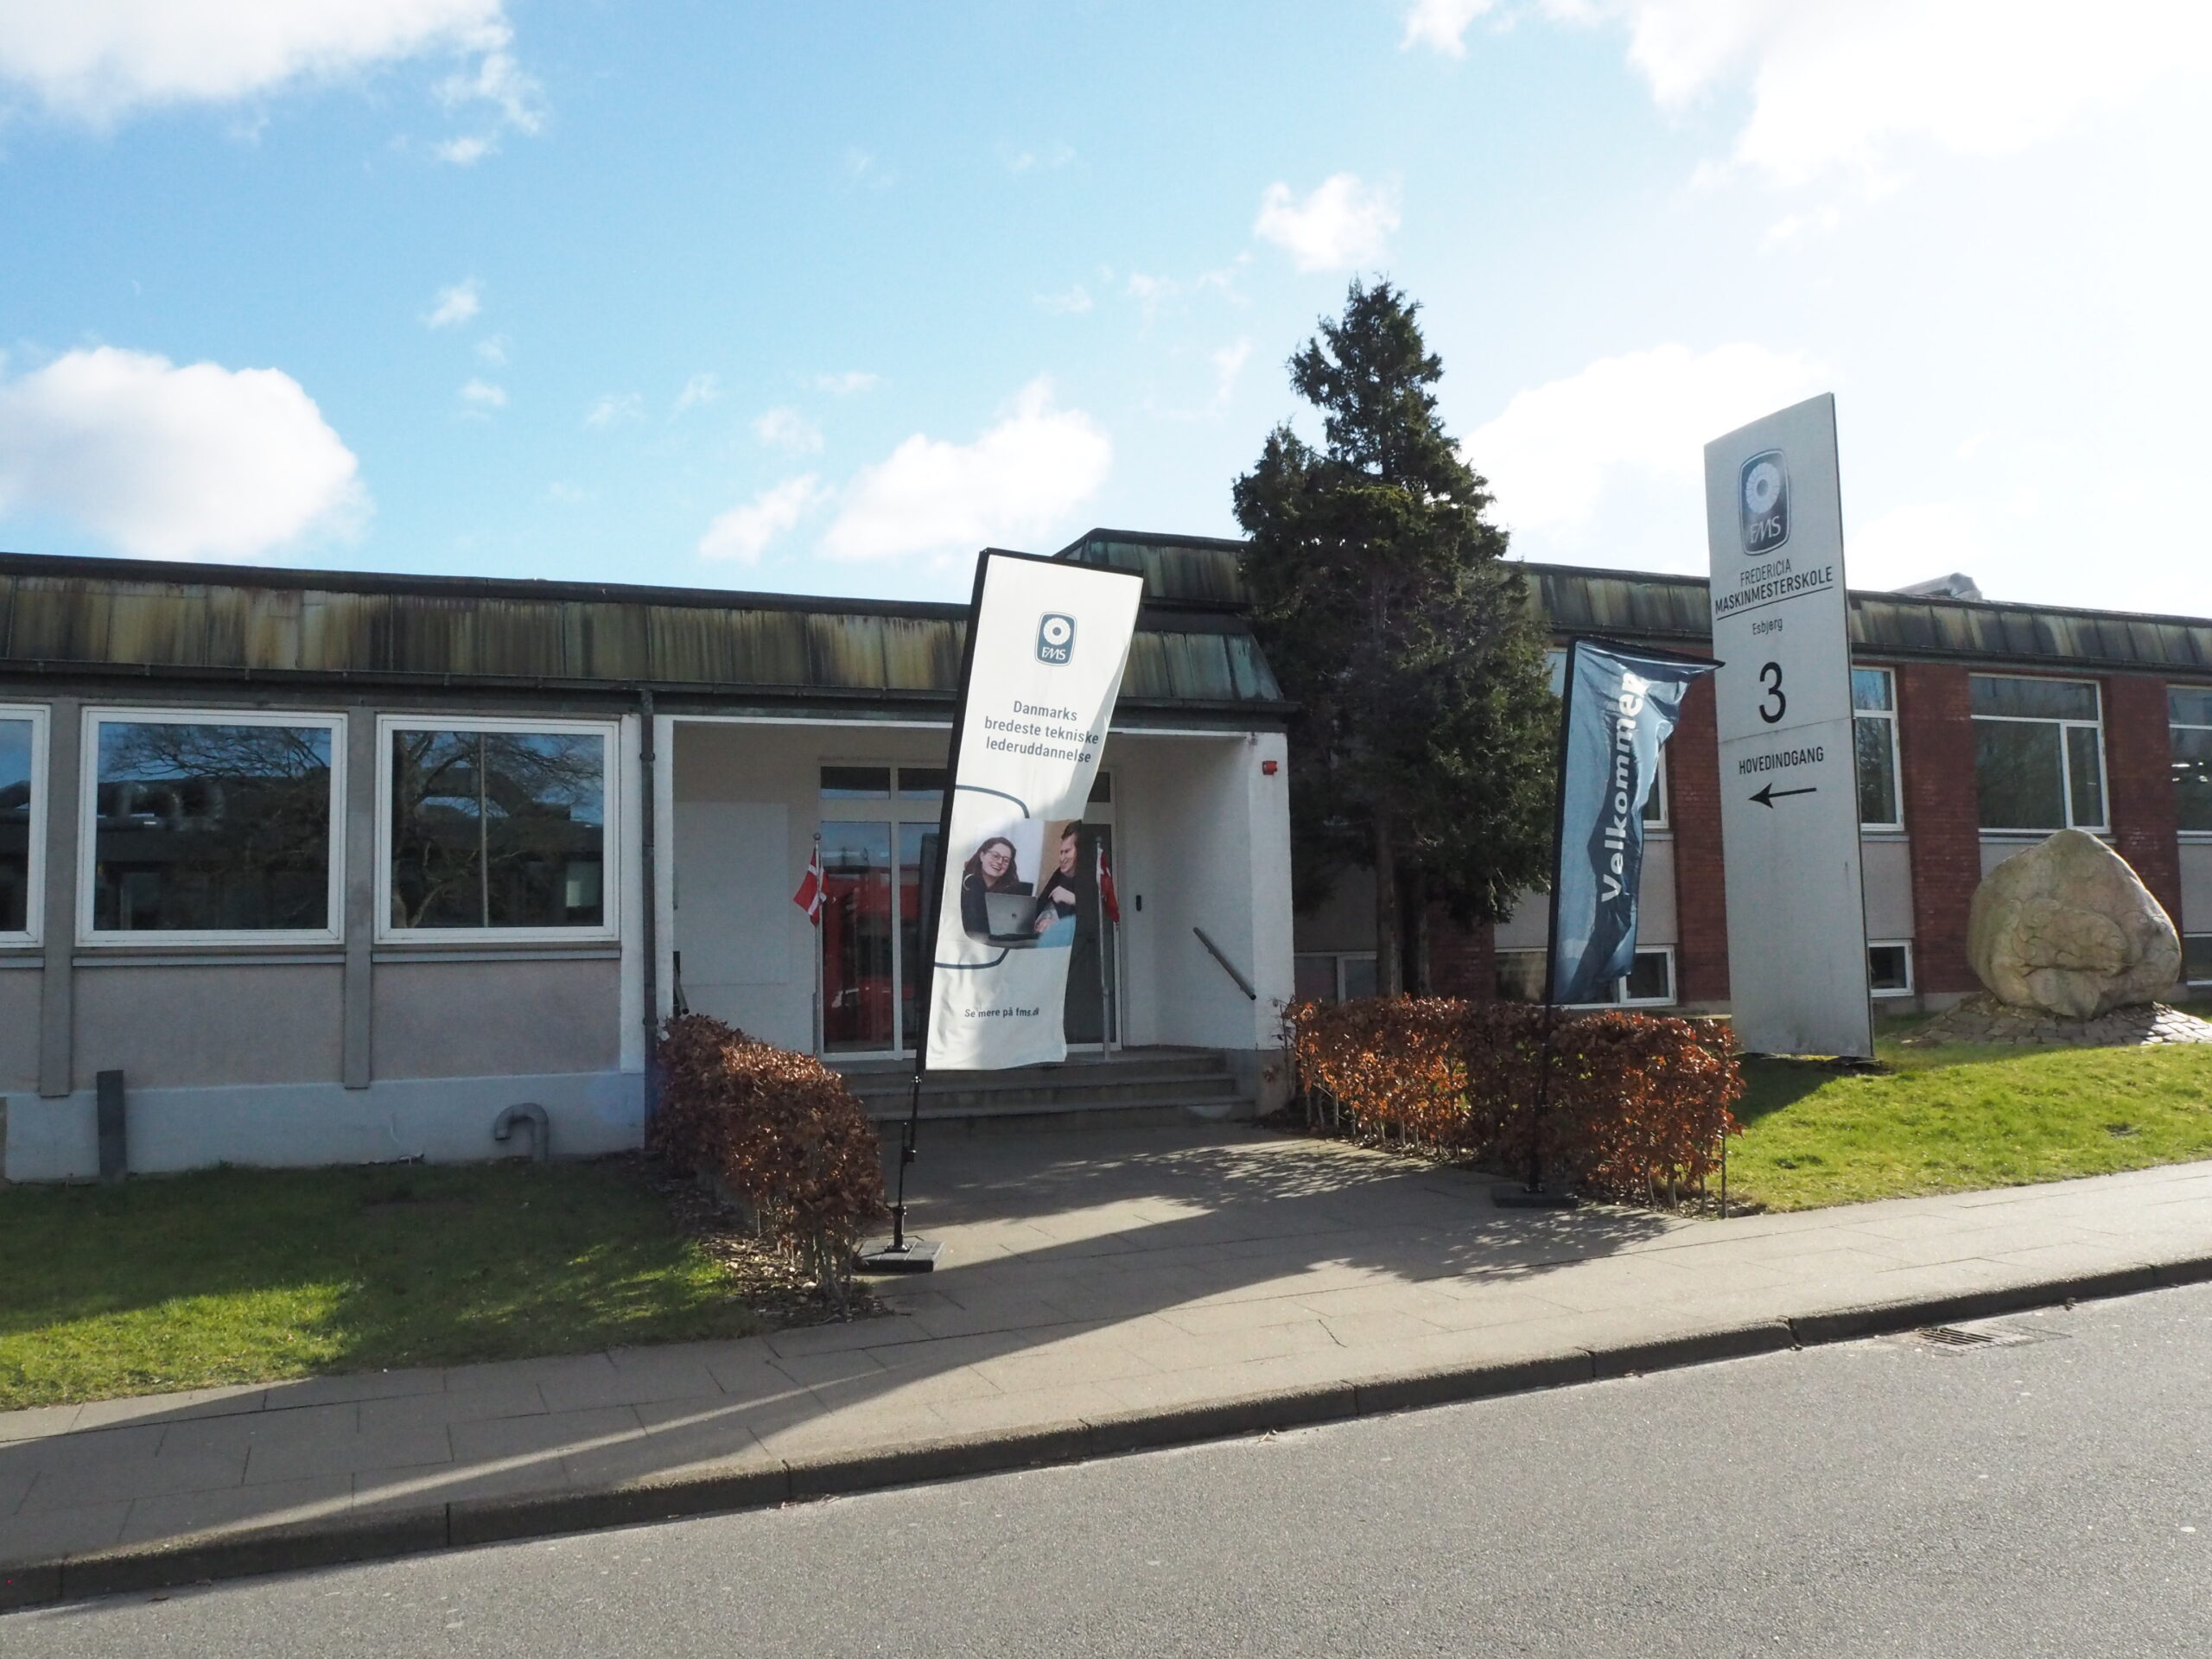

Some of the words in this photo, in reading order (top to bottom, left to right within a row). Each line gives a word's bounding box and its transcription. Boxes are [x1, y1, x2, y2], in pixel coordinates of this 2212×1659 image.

[1749, 516, 1782, 543] FMS
[1740, 558, 1792, 587] FREDERICIA
[1715, 566, 1834, 614] MASKINMESTERSKOLE
[1752, 617, 1783, 635] Esbjerg
[1042, 646, 1066, 661] FMS
[1759, 662, 1786, 723] 3
[1013, 700, 1077, 721] Danmarks
[984, 716, 1041, 736] bredeste
[1046, 727, 1099, 745] tekniske
[986, 736, 1091, 763] lederuddannelse
[1738, 747, 1824, 775] HOVEDINDGANG
[964, 1008, 976, 1018] Se
[978, 1009, 1000, 1018] mere
[1003, 1007, 1013, 1018] på
